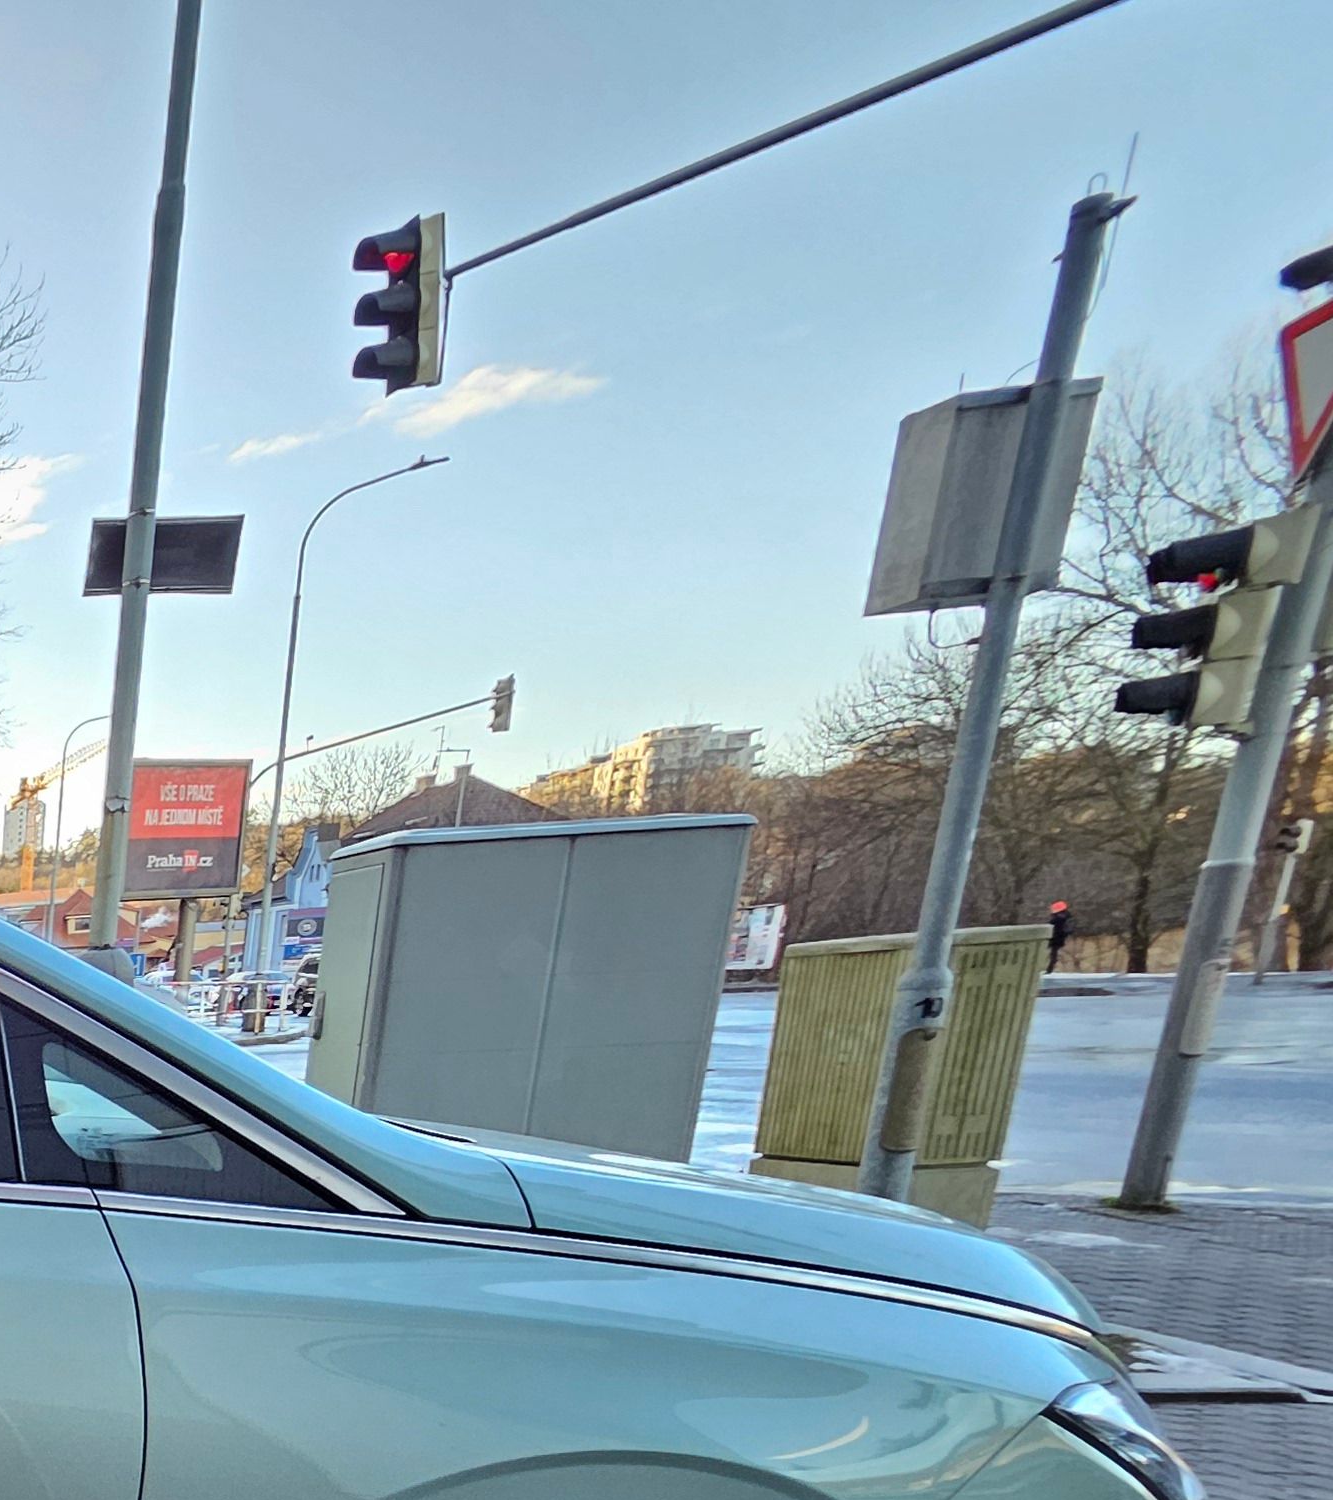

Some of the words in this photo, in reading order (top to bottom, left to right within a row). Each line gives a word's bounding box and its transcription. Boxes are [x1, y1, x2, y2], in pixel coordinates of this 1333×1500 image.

[160, 782, 178, 802] VŠE
[187, 784, 215, 802] PRAZE
[144, 808, 159, 826] NA
[160, 808, 196, 826] JEDNOM
[197, 806, 224, 826] MÍSTĚ
